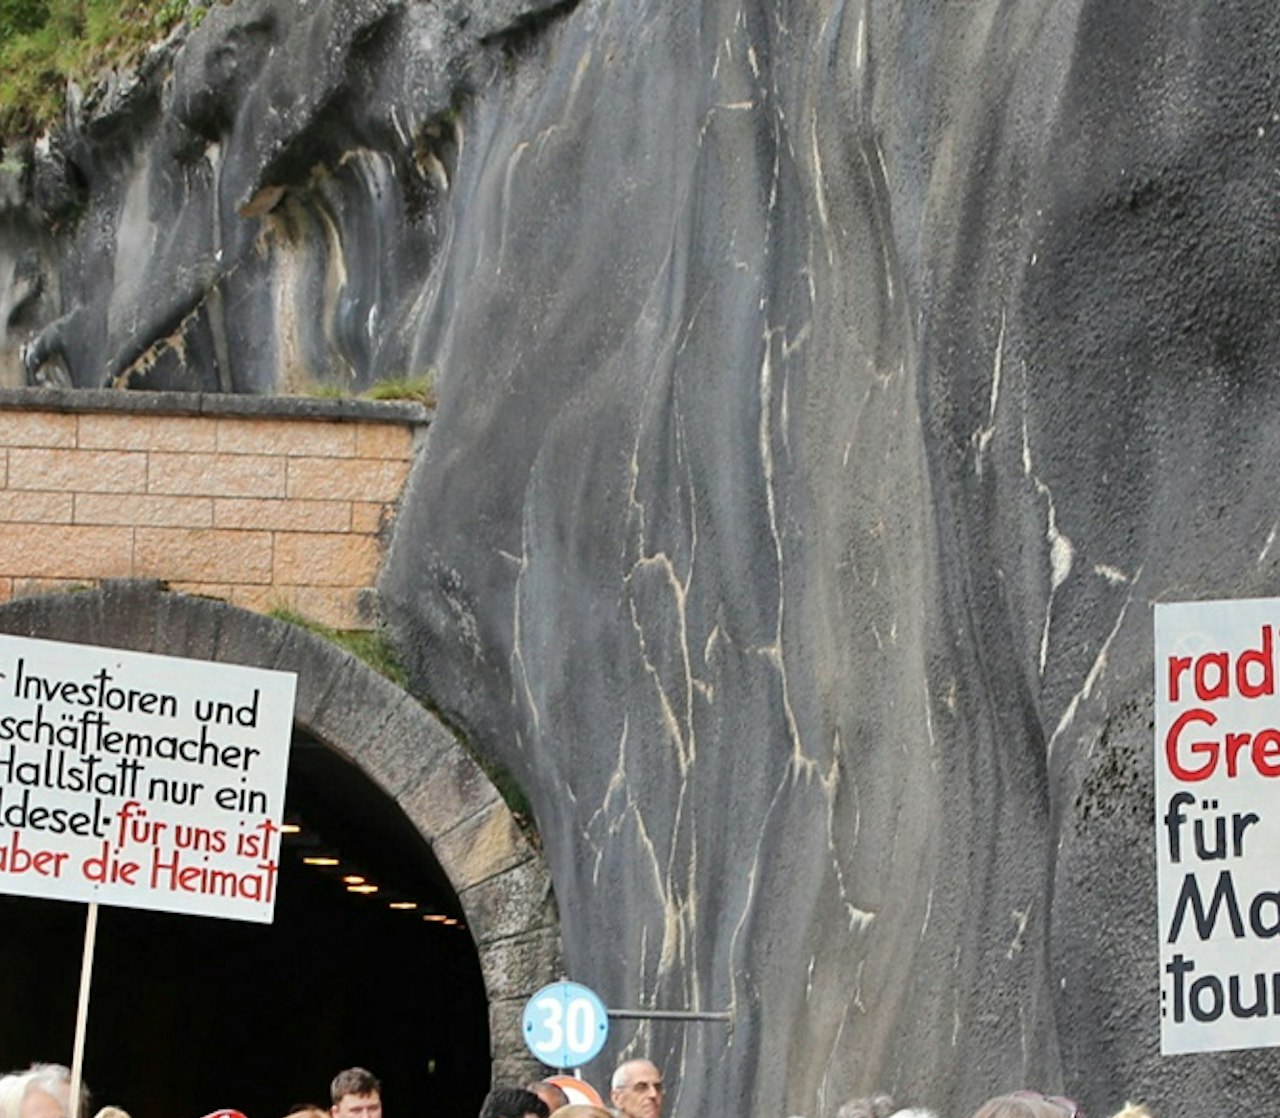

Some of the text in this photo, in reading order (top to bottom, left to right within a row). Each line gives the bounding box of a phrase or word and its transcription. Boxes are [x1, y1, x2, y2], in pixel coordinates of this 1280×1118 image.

[14, 658, 177, 717] Investoren
[195, 689, 260, 728] und
[148, 776, 203, 805] nur
[215, 777, 266, 814] ein
[117, 801, 166, 847] für
[175, 824, 226, 854] uns
[237, 819, 280, 860] ist
[1165, 792, 1259, 863] für
[82, 841, 140, 885] die
[150, 846, 278, 903] Heimat
[535, 999, 595, 1051] 30
